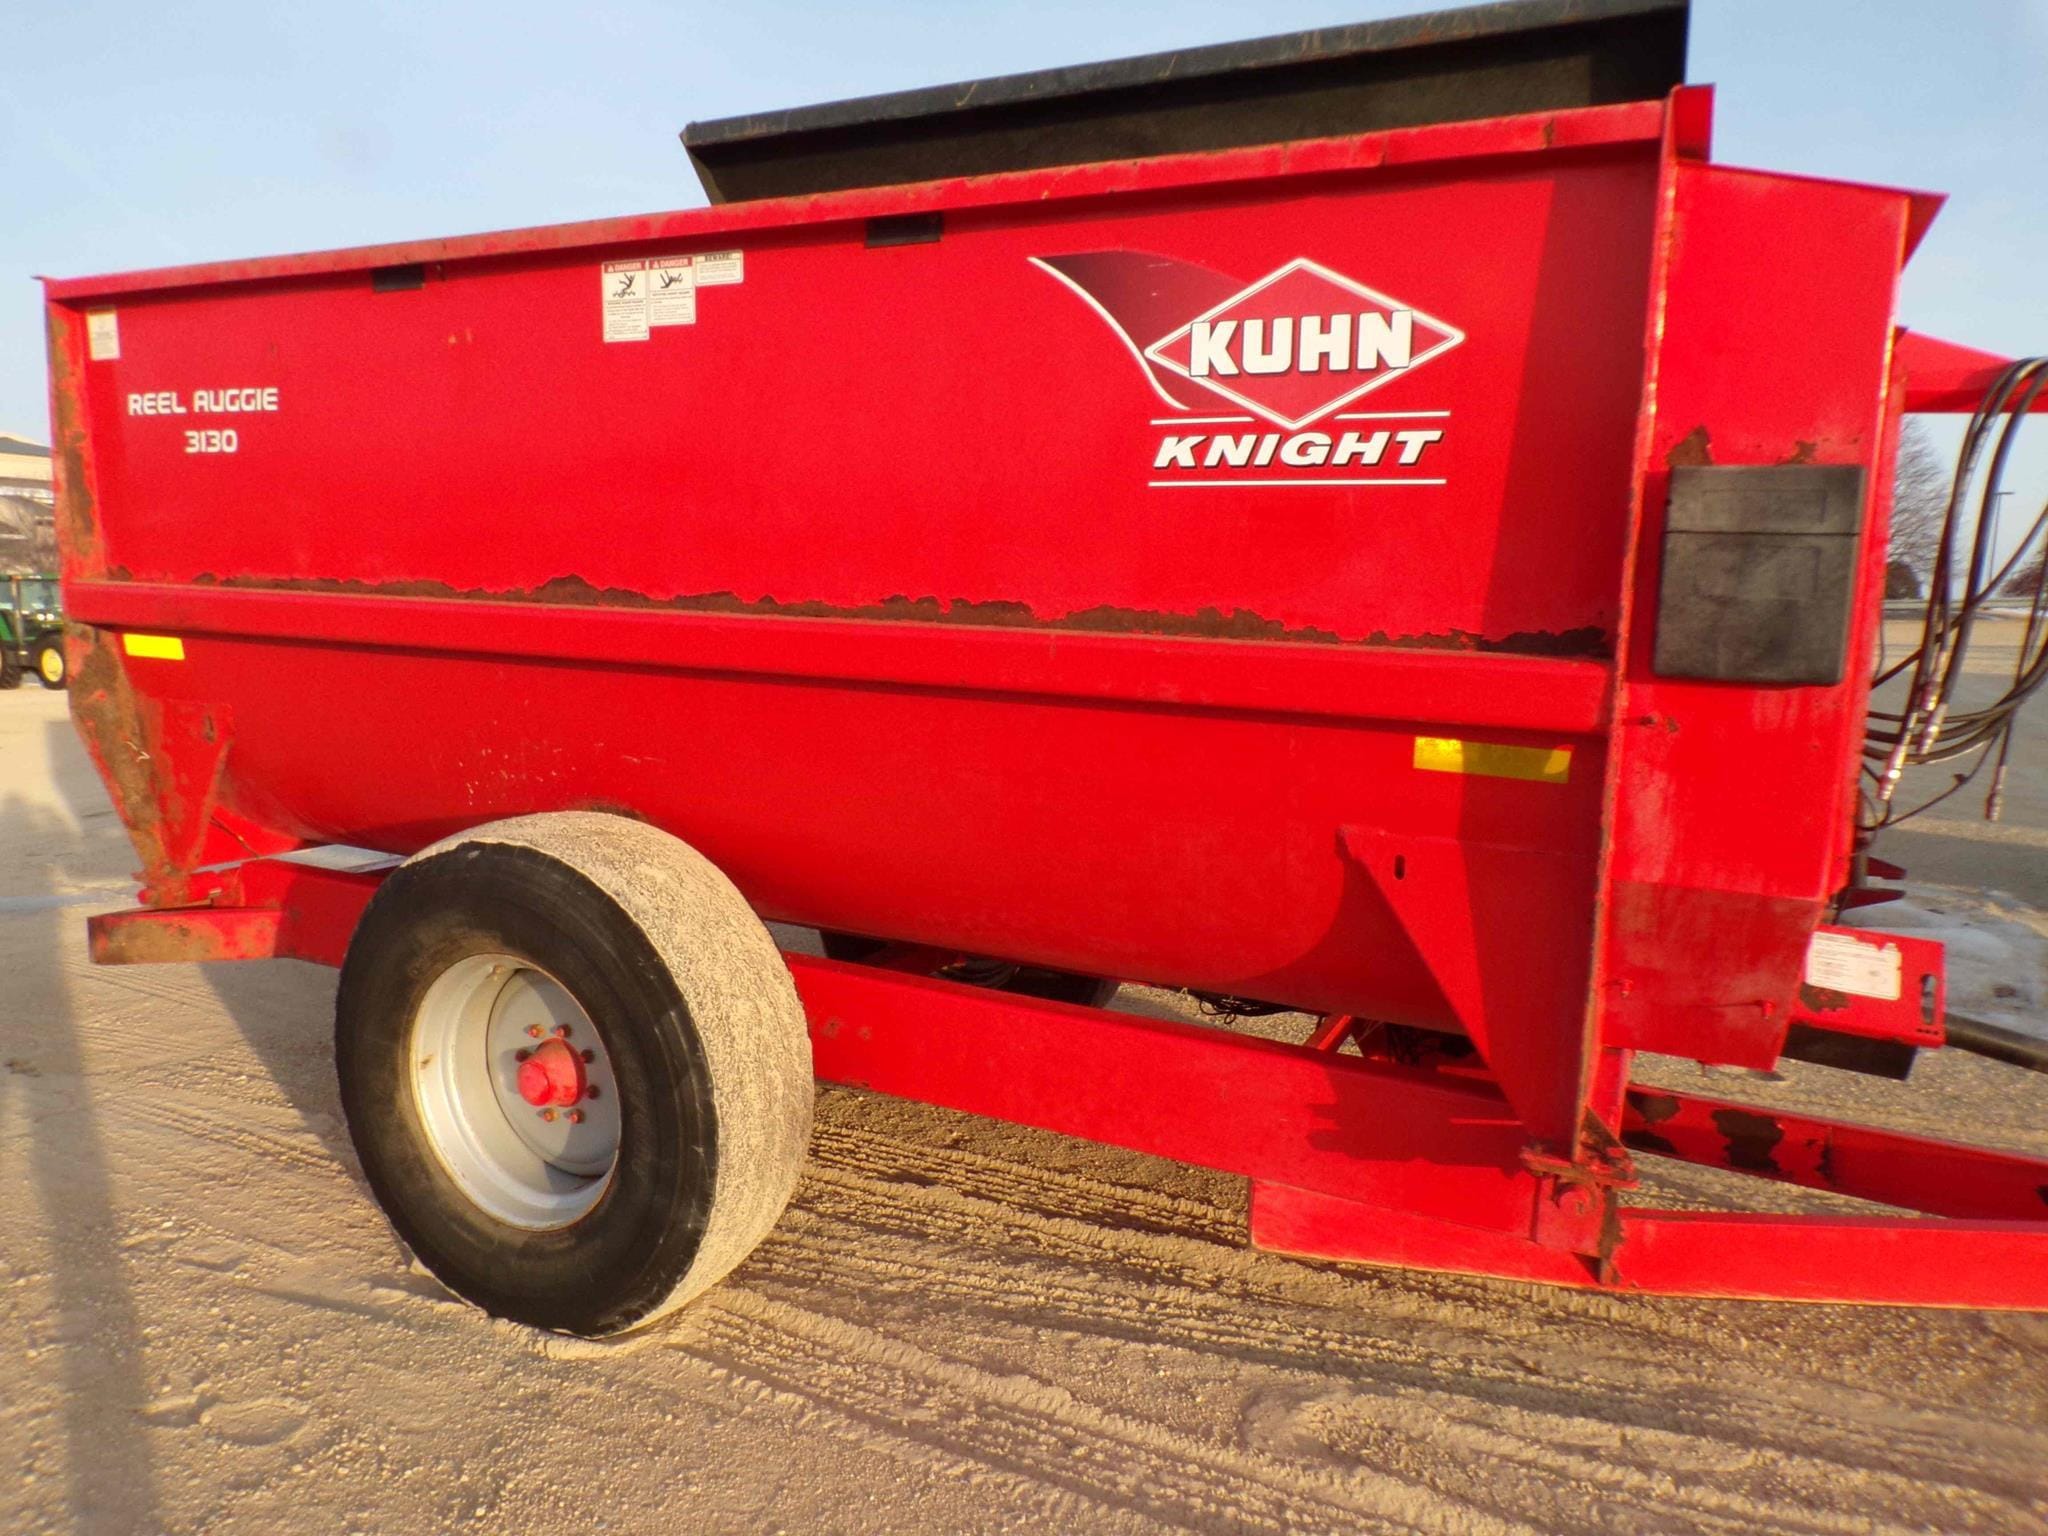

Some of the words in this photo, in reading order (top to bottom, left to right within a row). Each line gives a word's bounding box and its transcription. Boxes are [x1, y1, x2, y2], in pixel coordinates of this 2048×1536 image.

[1189, 311, 1412, 376] KUHN
[128, 393, 187, 415] REEL
[193, 388, 278, 412] AUGGIE
[185, 430, 237, 453] 3130
[1154, 431, 1443, 469] KNIGHT
